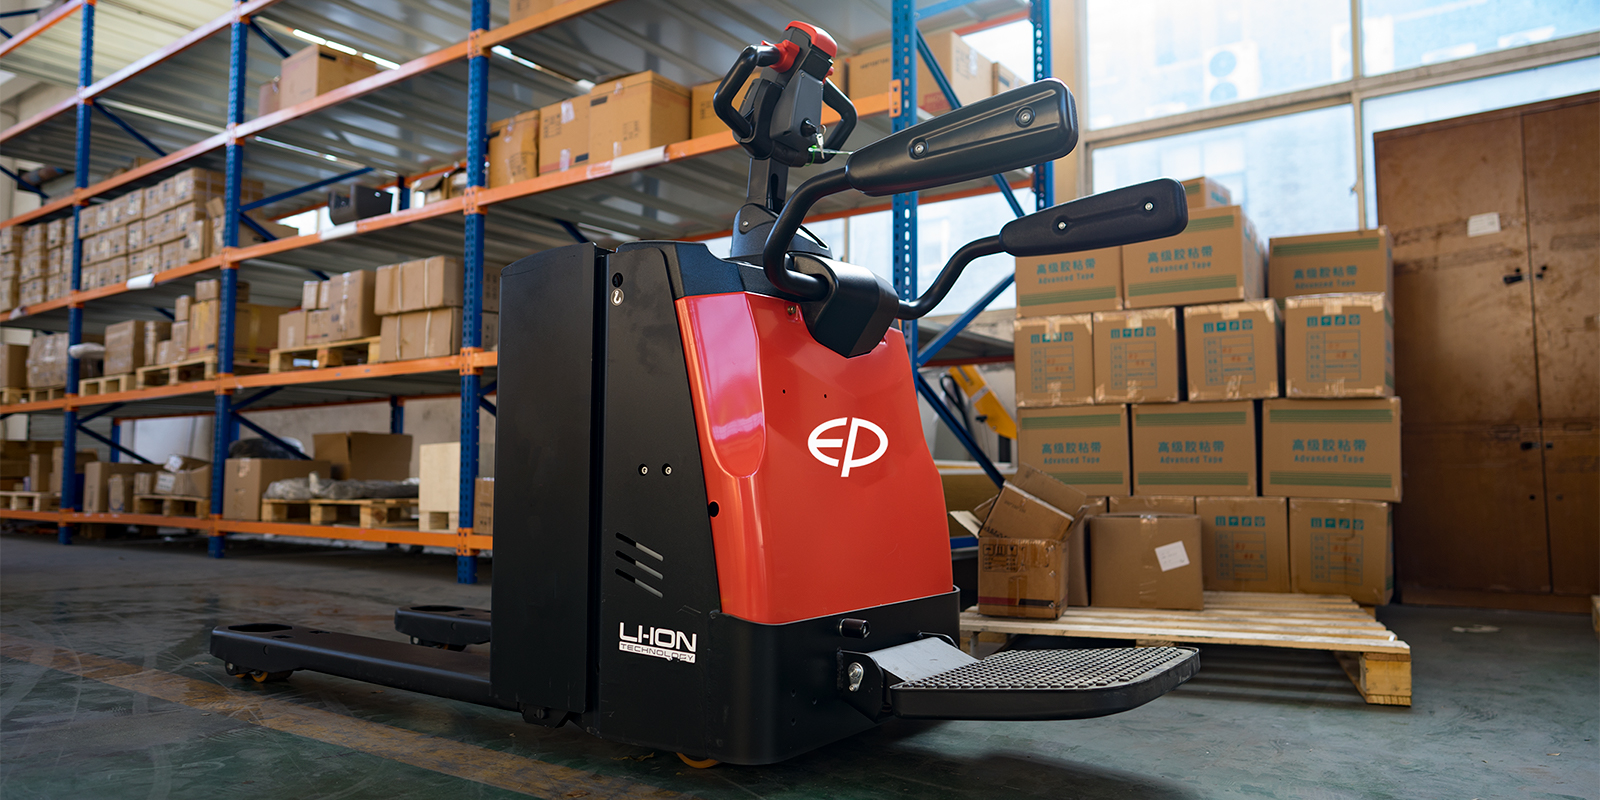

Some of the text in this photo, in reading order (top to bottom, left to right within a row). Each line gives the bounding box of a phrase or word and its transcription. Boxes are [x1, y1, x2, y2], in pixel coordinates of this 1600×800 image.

[1149, 261, 1212, 274] Advanced Tape
[1038, 273, 1095, 285] Advanced Tape
[1337, 279, 1356, 287] Tape
[808, 416, 889, 478] EP
[1043, 456, 1100, 464] Advanced Tape
[1159, 455, 1224, 464] Advanced Tape
[1294, 454, 1365, 464] Advanced Tape
[620, 642, 695, 662] TECHNOLOGY
